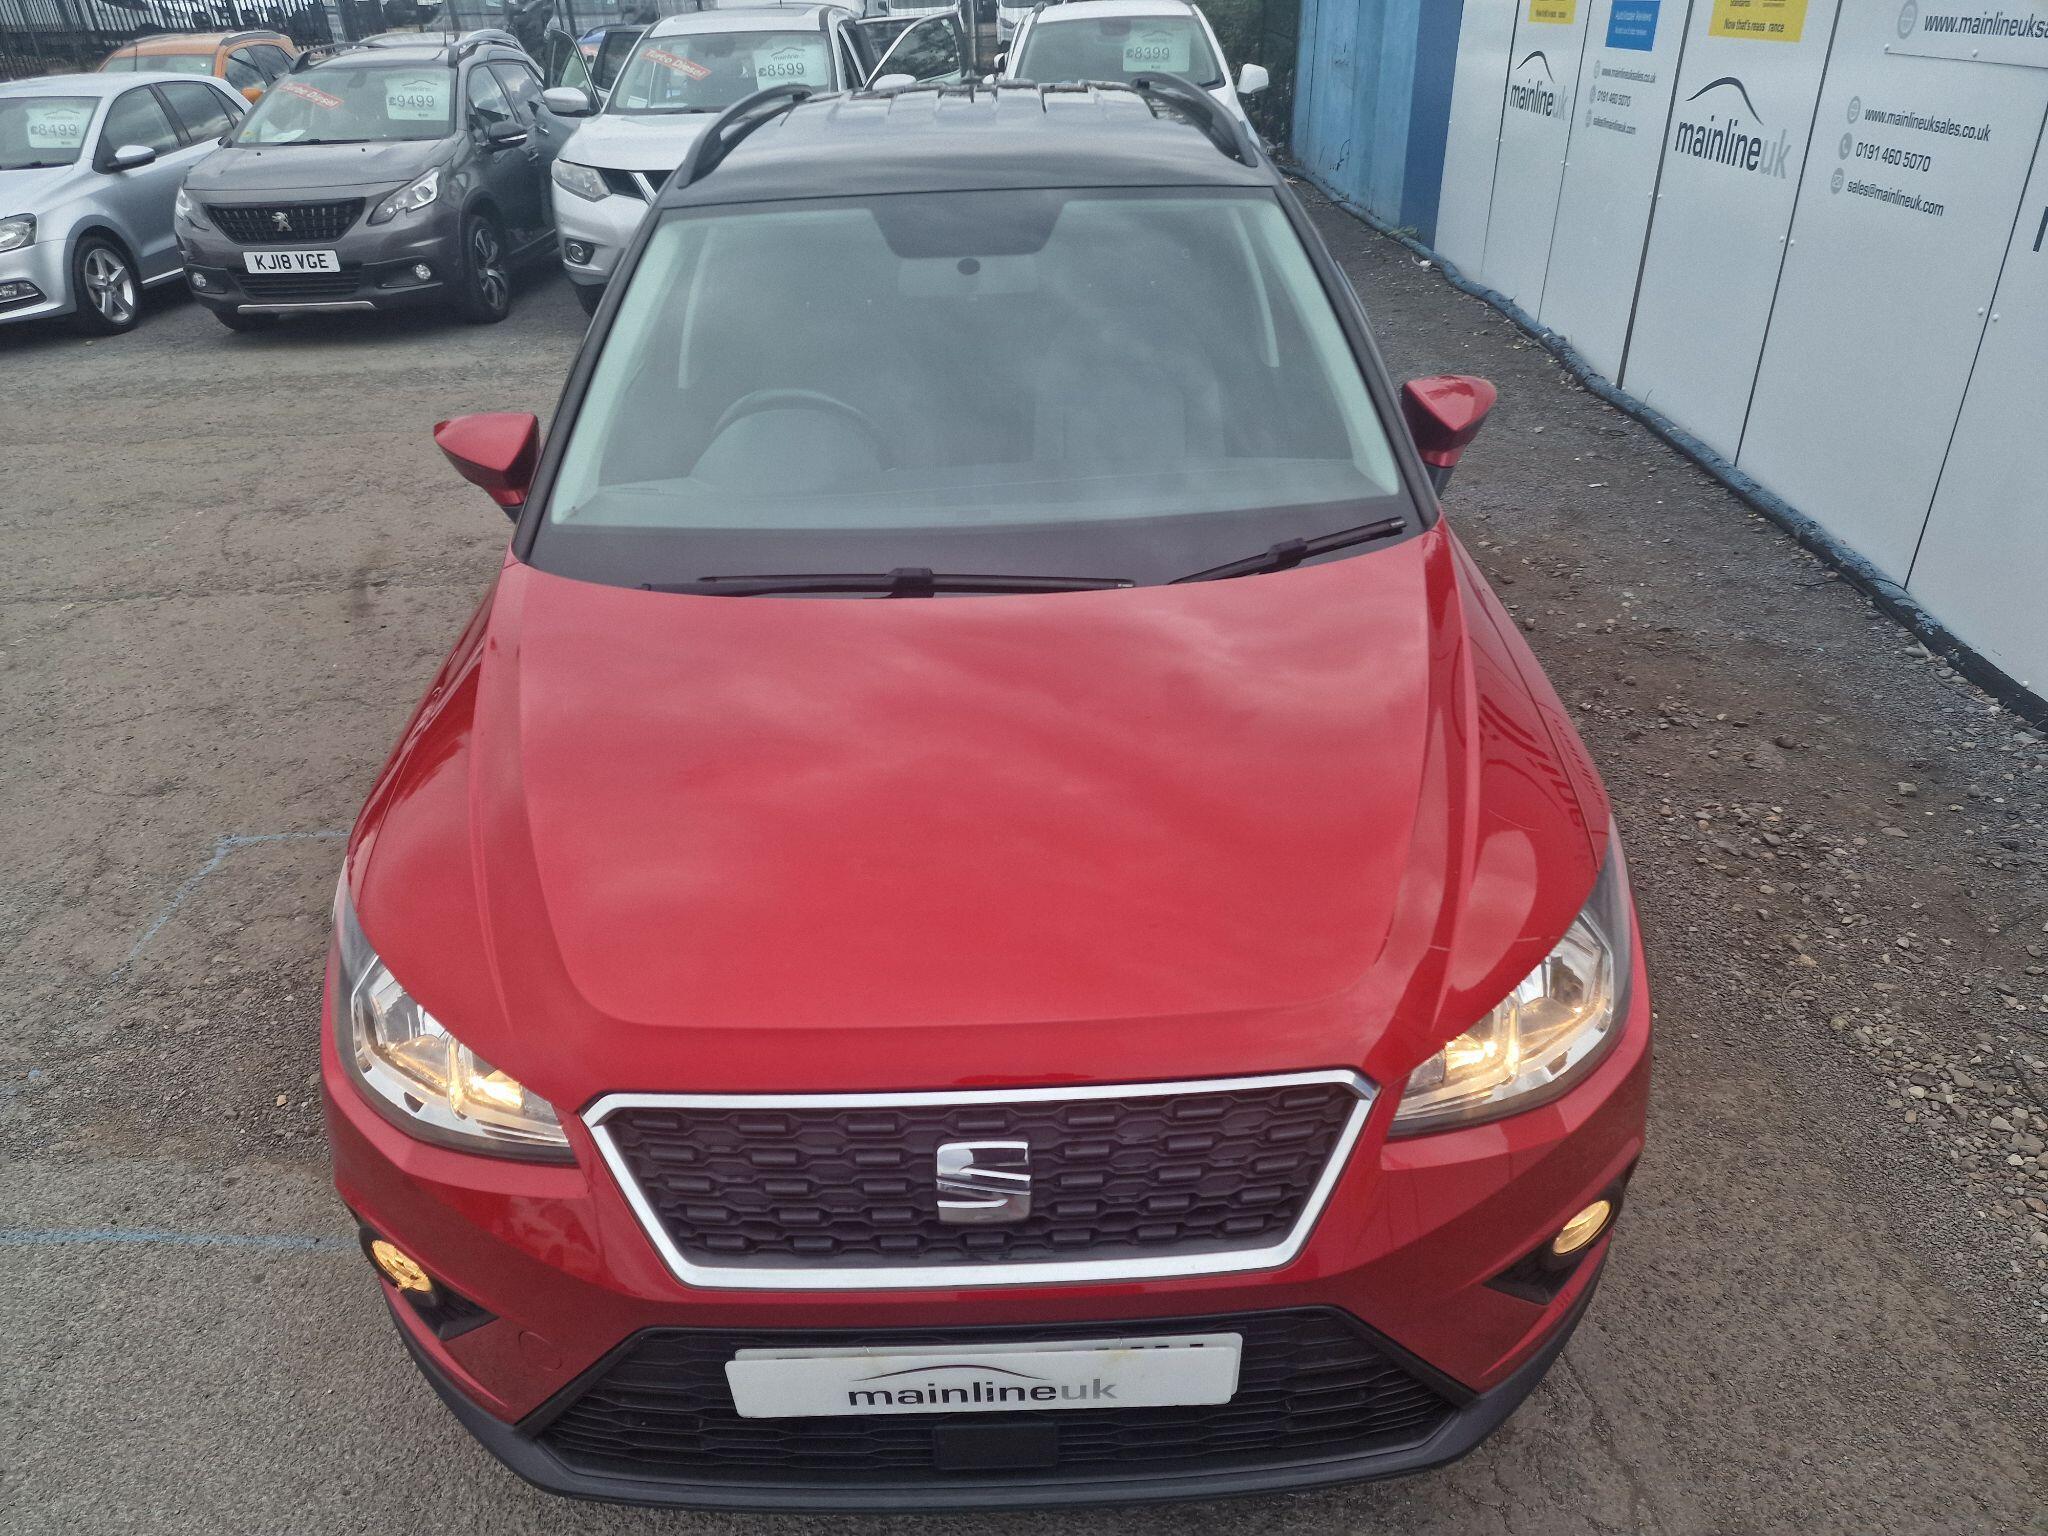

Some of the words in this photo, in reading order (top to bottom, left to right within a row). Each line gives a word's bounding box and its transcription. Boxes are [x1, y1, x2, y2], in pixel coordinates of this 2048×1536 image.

[1724, 18, 1735, 30] Now
[1509, 78, 1569, 120] mainlineuk
[1864, 107, 1991, 142] www.mainlineuksales.co.uk
[1674, 115, 1792, 179] mainlineuk
[1855, 142, 1880, 161] 0191
[1881, 148, 1902, 168] 460
[1902, 154, 1931, 172] 5070
[1847, 179, 1944, 217] sales@mainlineuk.com
[254, 254, 292, 270] KJ18
[295, 253, 329, 269] VGE
[848, 1378, 1119, 1407] mainlineuk
